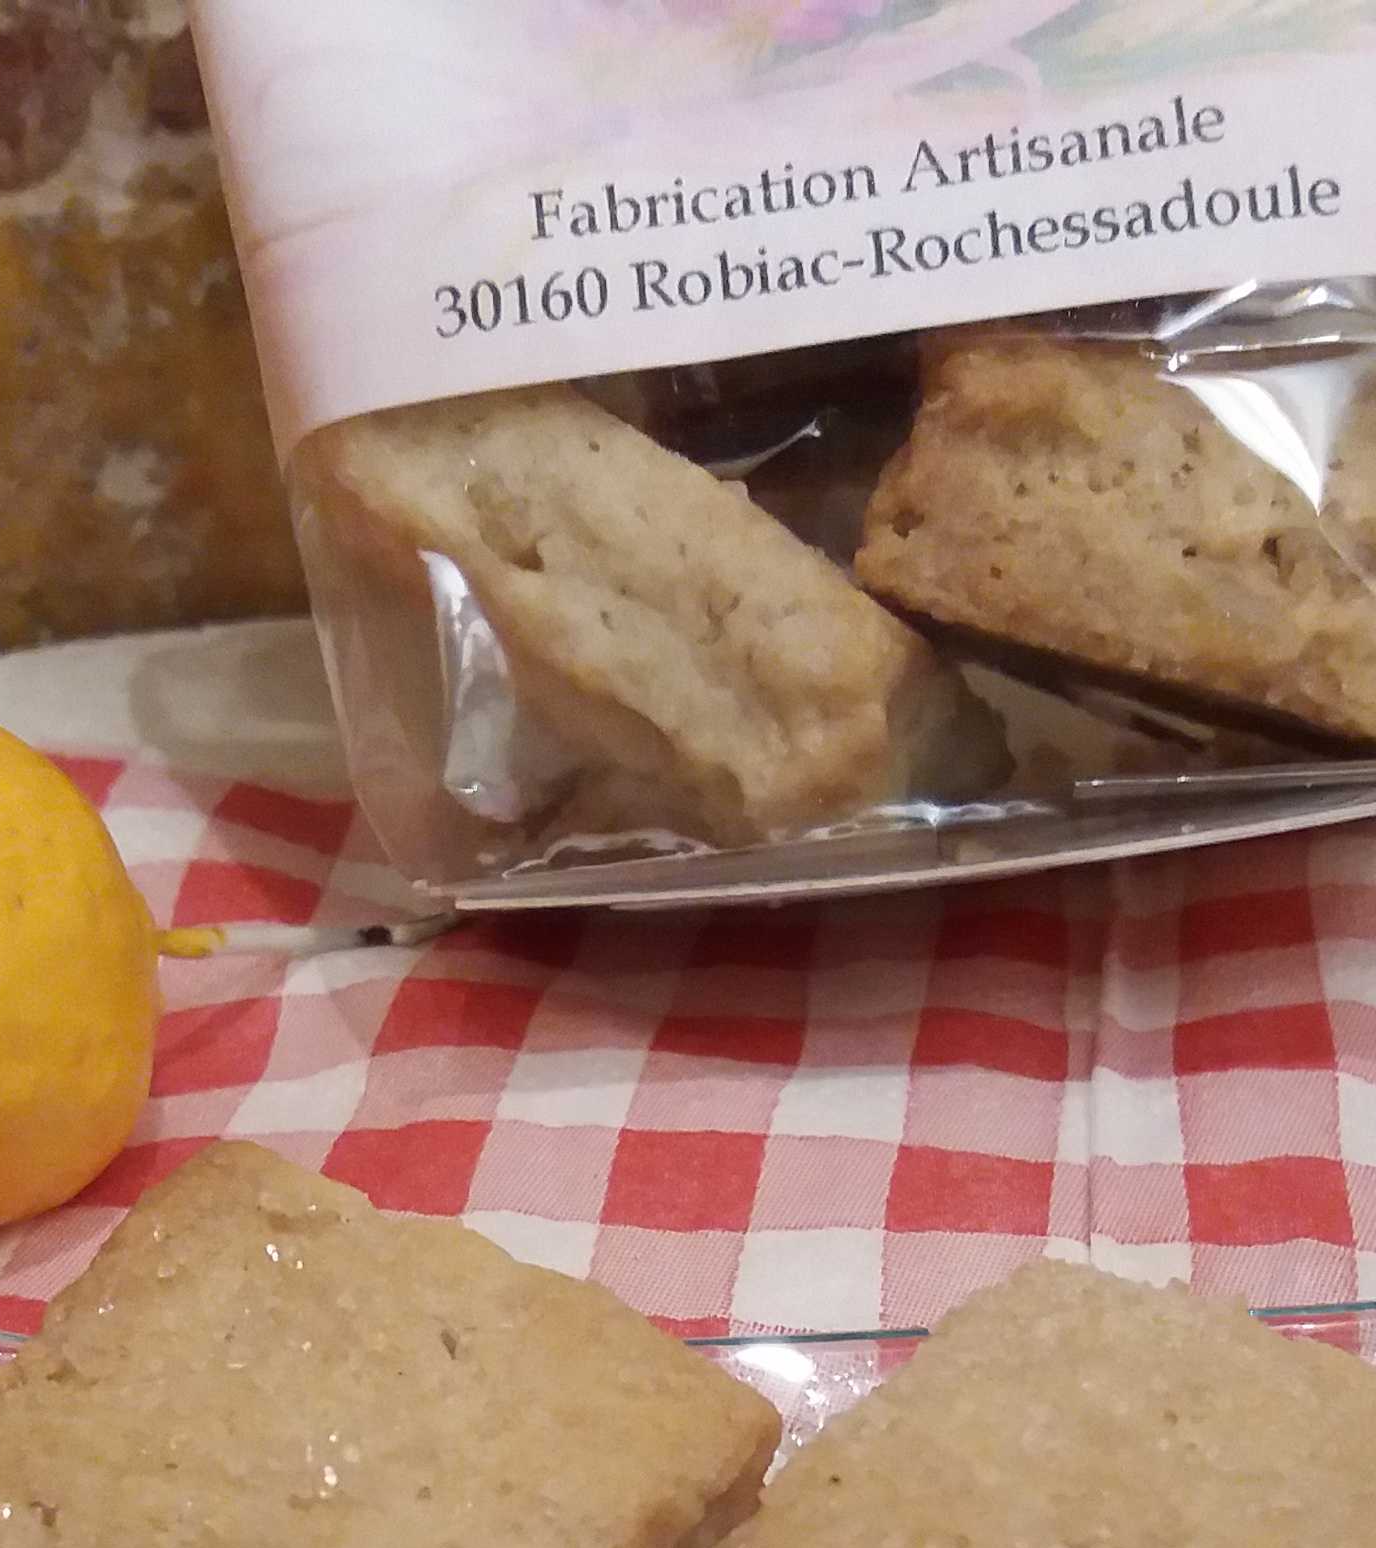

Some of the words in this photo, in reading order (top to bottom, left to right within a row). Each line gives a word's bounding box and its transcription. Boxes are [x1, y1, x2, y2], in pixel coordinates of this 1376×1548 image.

[528, 162, 879, 241] Fabrication
[900, 95, 1225, 193] Artisanale
[434, 266, 608, 339] 30160
[628, 163, 1341, 312] Robiac-Rochessadoule
